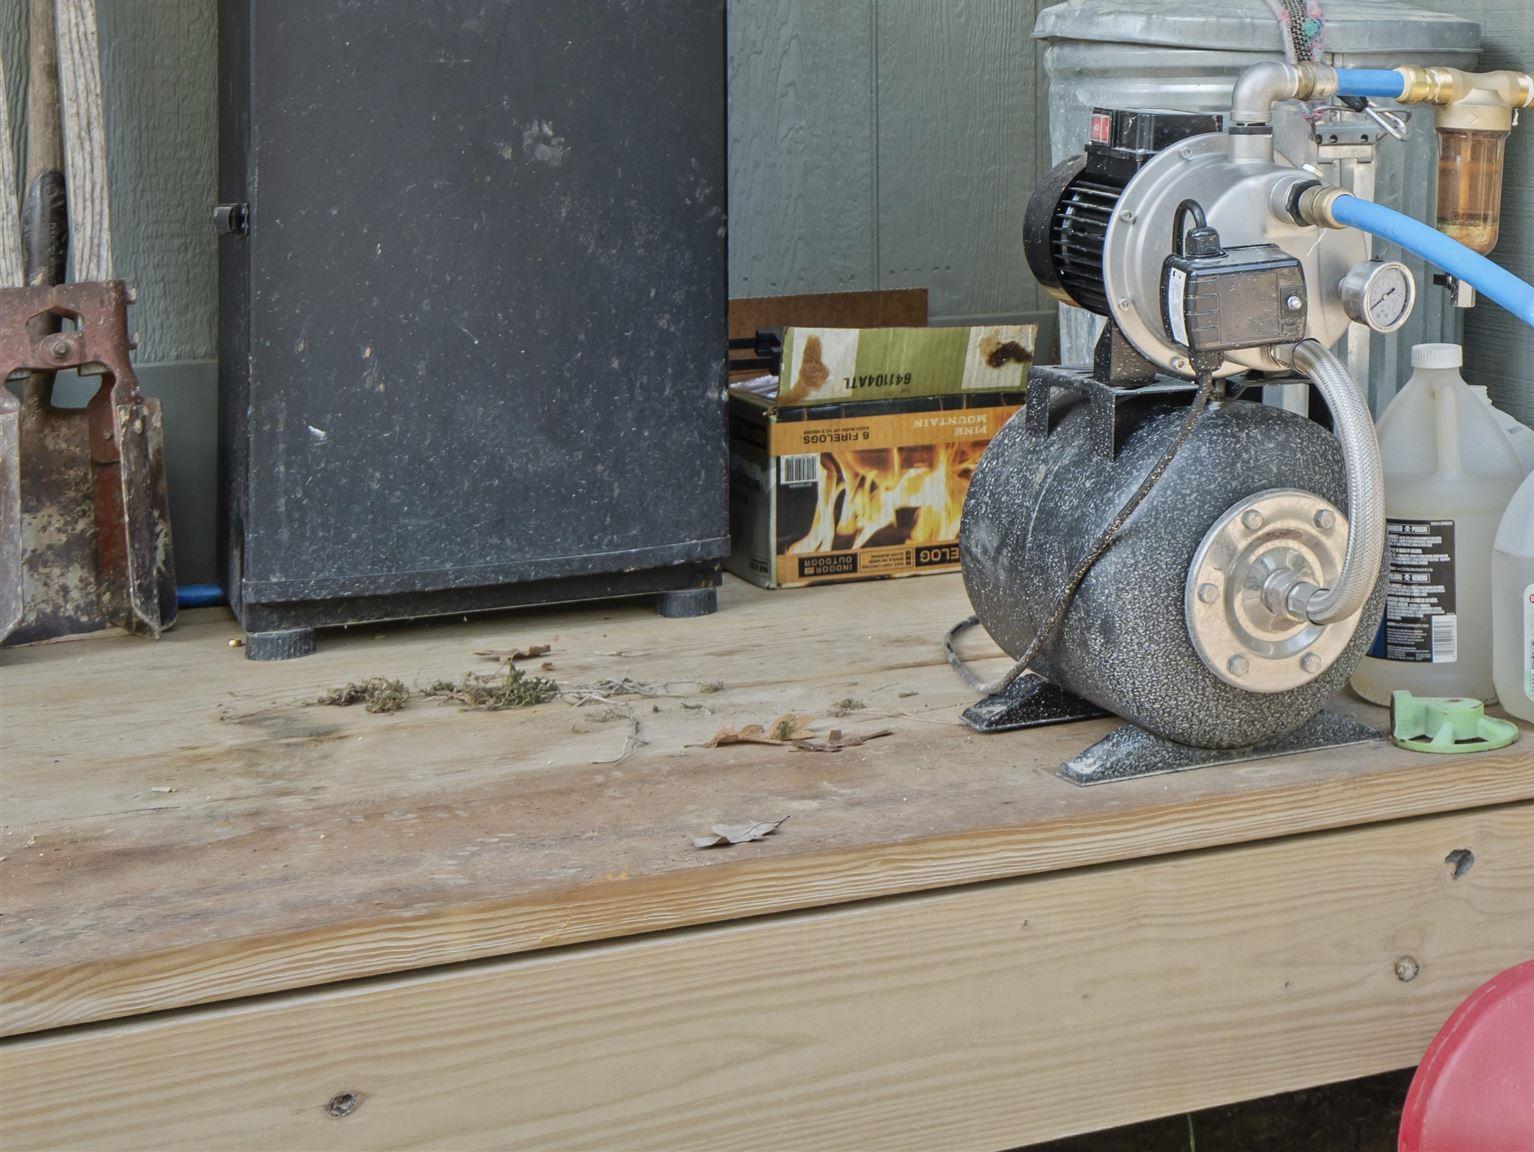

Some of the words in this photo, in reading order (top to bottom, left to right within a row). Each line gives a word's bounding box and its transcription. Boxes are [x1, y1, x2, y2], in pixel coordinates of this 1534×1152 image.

[843, 373, 912, 390] 641104ATL
[912, 414, 987, 428] MOUNTAIN
[954, 425, 987, 436] PINE
[803, 432, 859, 445] FIRELOGS
[804, 555, 853, 567] OUTDOOR
[816, 564, 853, 574] INDOOR
